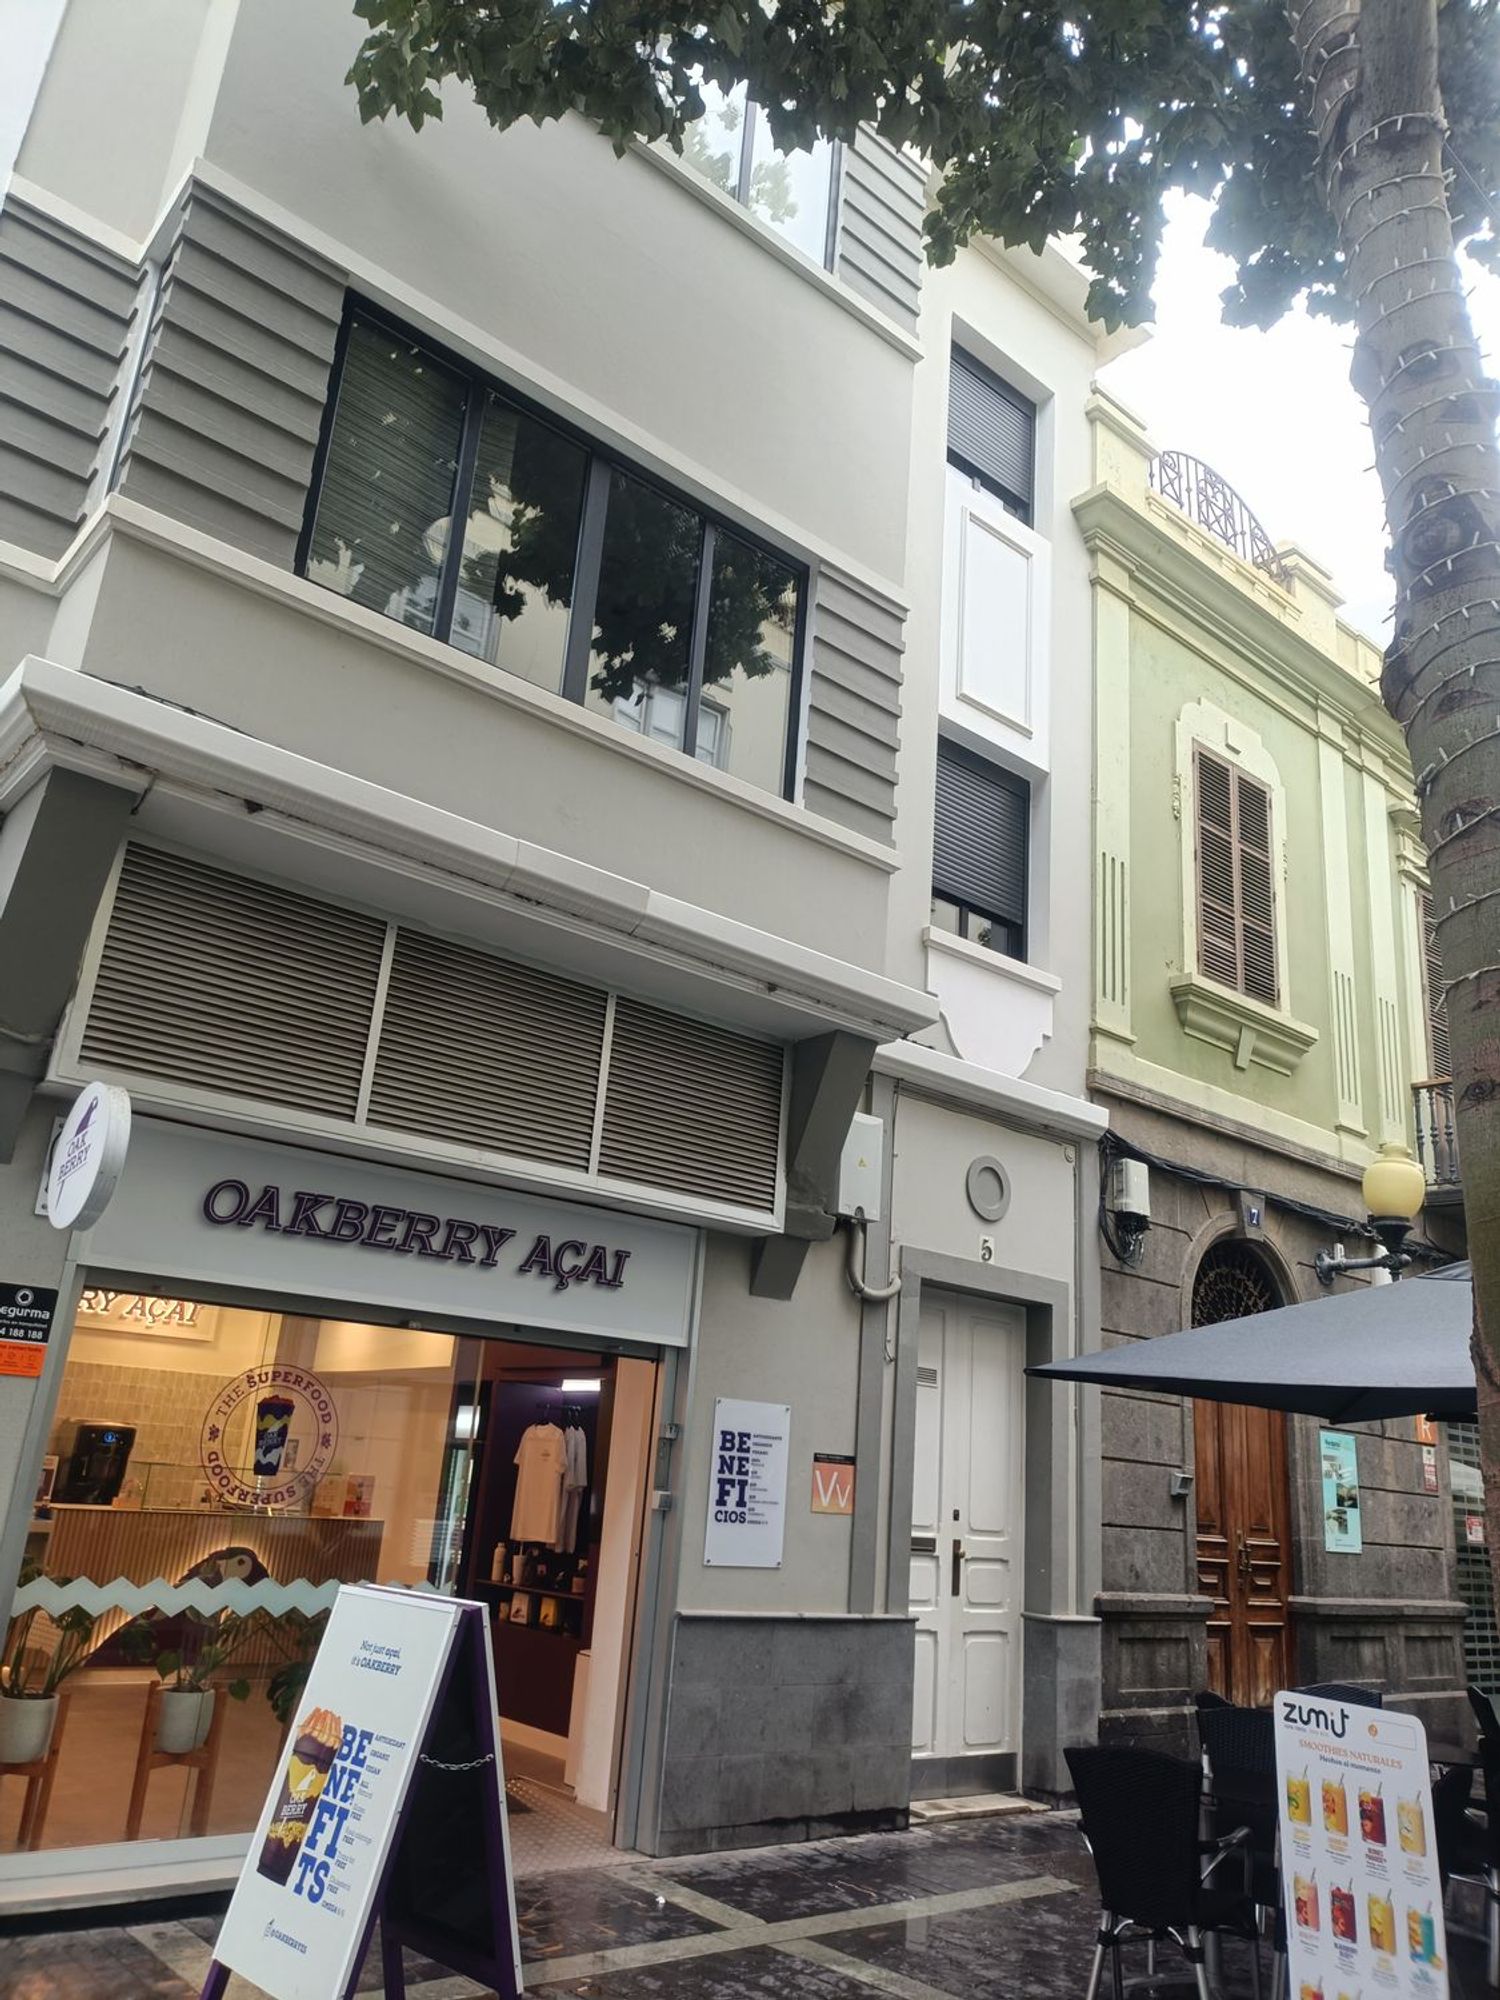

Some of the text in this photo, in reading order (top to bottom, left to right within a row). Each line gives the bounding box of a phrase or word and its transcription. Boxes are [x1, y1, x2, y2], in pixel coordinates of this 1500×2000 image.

[58, 1143, 91, 1180] BERRY
[203, 1178, 632, 1290] OAKBERRY AÇAI
[1251, 1208, 1259, 1225] 7
[981, 1239, 993, 1262] 5
[216, 1370, 333, 1425] THE SUPERFOOD
[719, 1430, 751, 1454] BE
[207, 1451, 297, 1506] SUPERFOOD
[718, 1454, 750, 1476] NE
[715, 1477, 749, 1508] FI
[714, 1509, 747, 1524] CIOS
[360, 1657, 402, 1676] OAKBERRY
[336, 1723, 375, 1769] BE
[322, 1763, 362, 1804] NE
[304, 1797, 350, 1860] FI
[293, 1852, 331, 1904] TS
